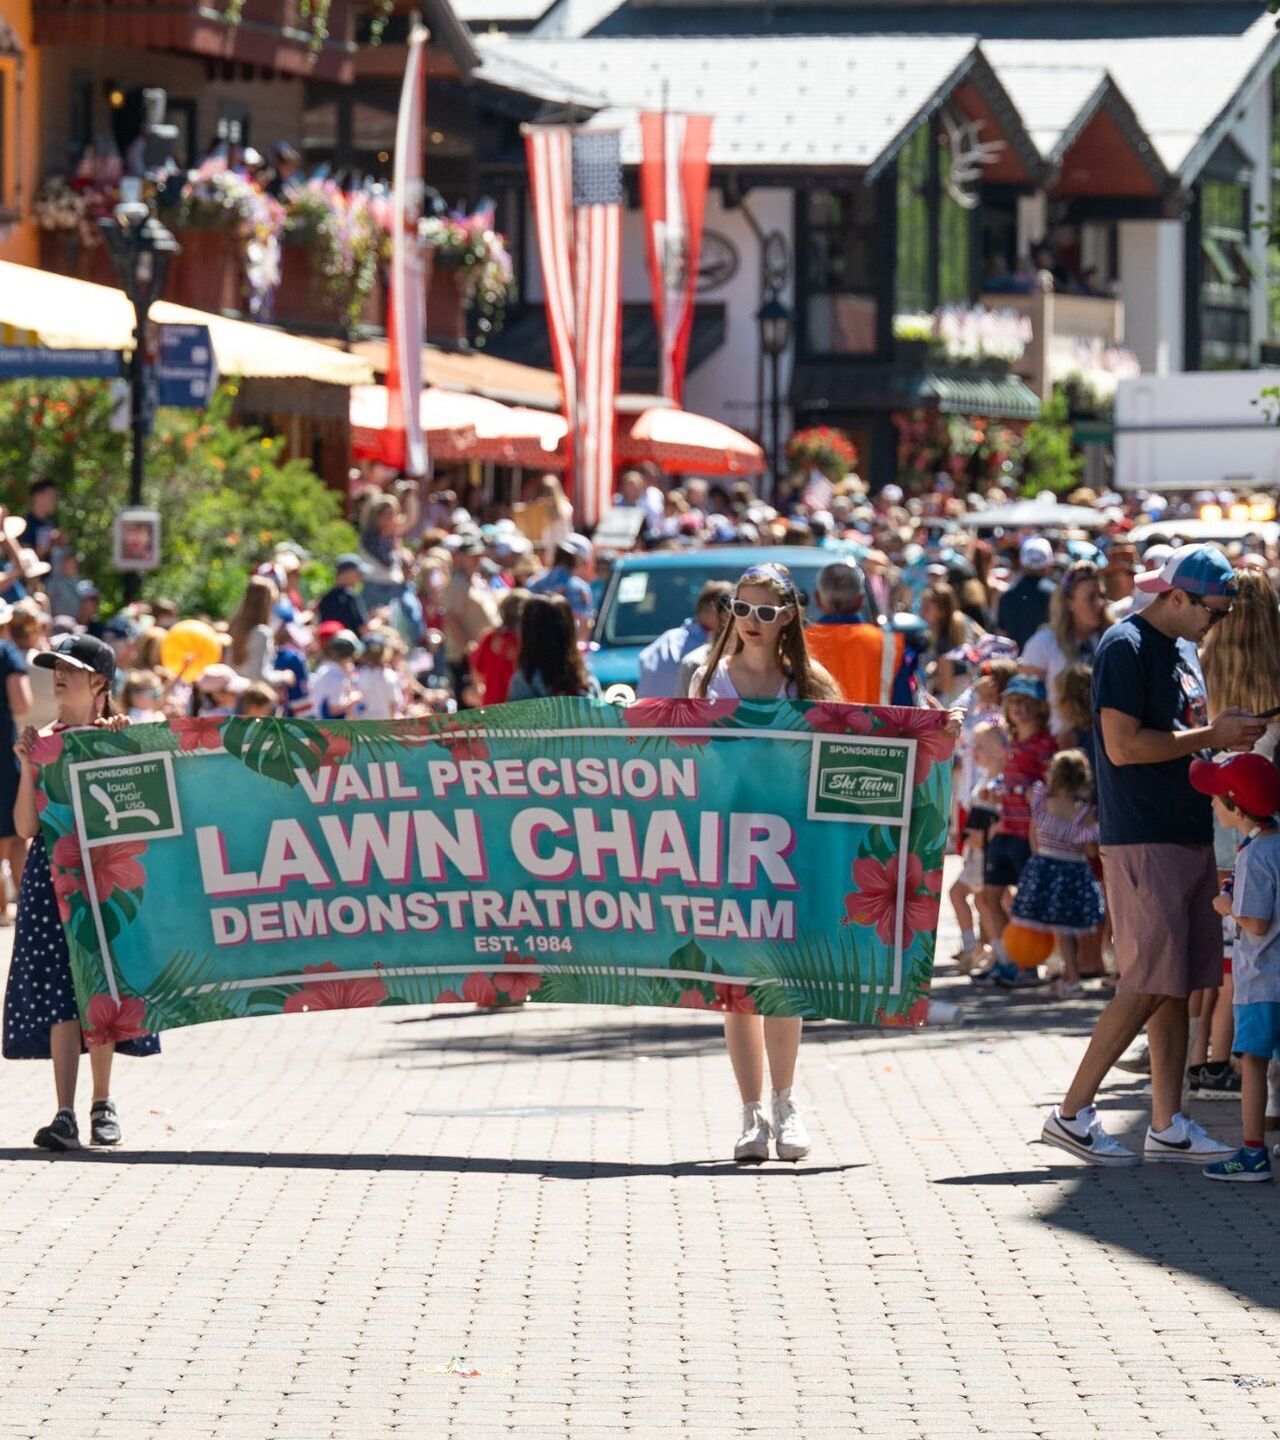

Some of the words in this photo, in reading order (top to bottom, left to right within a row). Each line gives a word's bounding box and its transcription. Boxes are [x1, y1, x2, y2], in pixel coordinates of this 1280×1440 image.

[830, 745, 887, 757] SPONSORED
[889, 749, 905, 758] BY:
[86, 766, 141, 780] SPONSORED
[144, 764, 158, 774] BY:
[294, 761, 419, 804] VAIL
[427, 757, 698, 800] PRECISION
[107, 782, 135, 793] lawn
[829, 774, 857, 789] Ski
[859, 776, 894, 792] Town
[114, 792, 142, 803] chair
[195, 808, 489, 898] LAWN
[510, 806, 801, 891] CHAIR
[210, 889, 656, 946] DEMONSTRATION
[660, 894, 796, 942] TEAM
[474, 935, 519, 953] EST.
[524, 935, 573, 953] 1984
